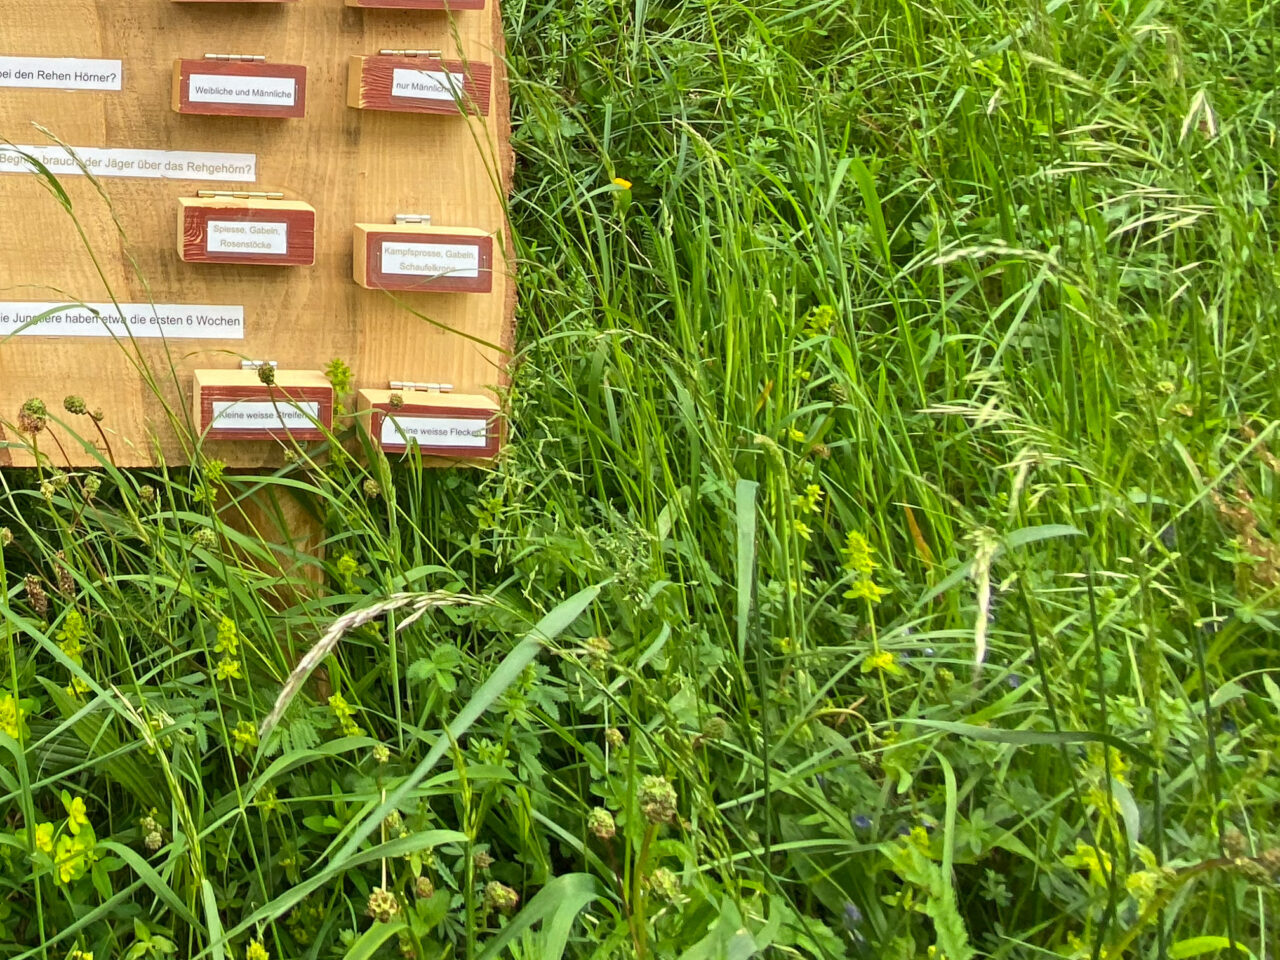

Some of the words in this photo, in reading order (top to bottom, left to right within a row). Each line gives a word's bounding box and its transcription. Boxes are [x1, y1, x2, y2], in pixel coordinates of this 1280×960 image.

[14, 69, 34, 79] den
[37, 70, 71, 81] Rehen
[74, 71, 117, 82] Hörner?
[396, 82, 410, 90] nur
[195, 86, 233, 96] Weibliche
[235, 88, 250, 97] und
[252, 89, 292, 99] Männliche
[85, 157, 101, 168] der
[104, 156, 134, 171] Jäger
[137, 158, 161, 170] über
[164, 160, 185, 171] das
[187, 161, 252, 175] Rehgehörn?
[213, 224, 248, 235] Spiesse,
[249, 226, 281, 236] Gabeln,
[220, 239, 272, 250] Rosenstöcke
[384, 247, 444, 259] Kampfsprosse,
[65, 313, 99, 324] haben
[130, 315, 147, 325] die
[150, 316, 183, 326] ersten
[186, 315, 193, 326] 6
[197, 315, 241, 326] Wochen
[219, 411, 244, 420] Kleine
[246, 411, 274, 420] weisse
[421, 428, 448, 437] weisse
